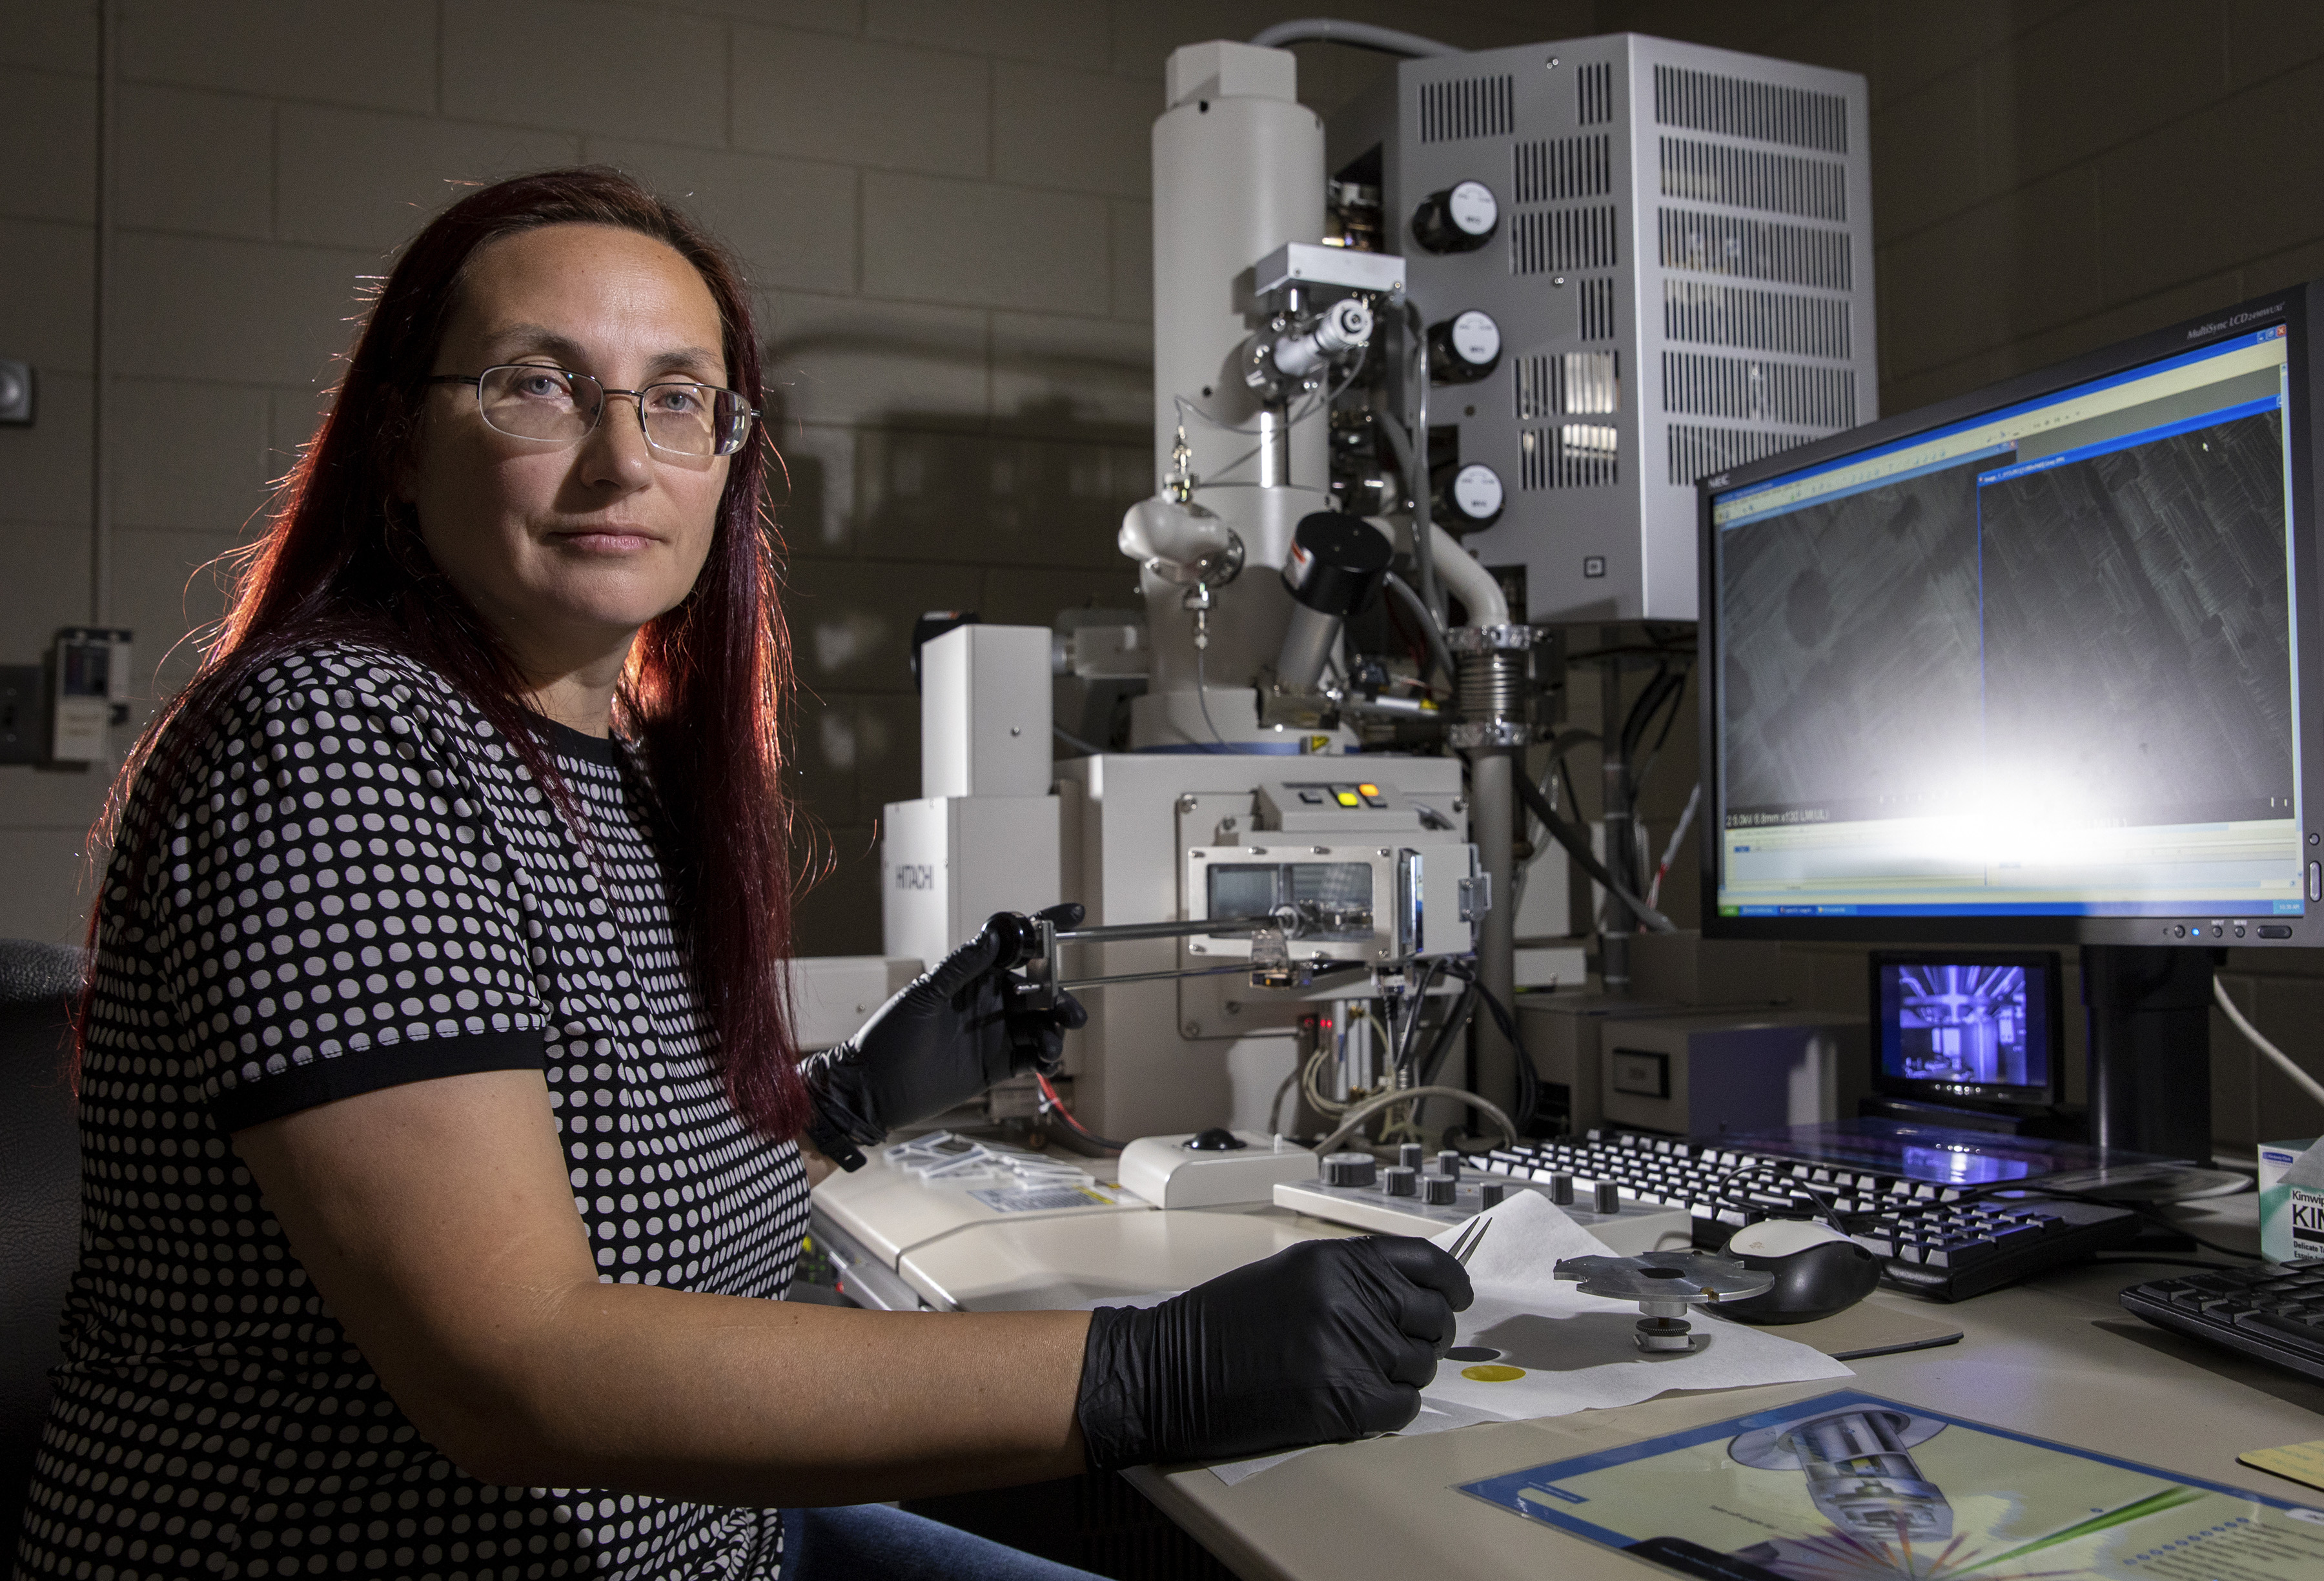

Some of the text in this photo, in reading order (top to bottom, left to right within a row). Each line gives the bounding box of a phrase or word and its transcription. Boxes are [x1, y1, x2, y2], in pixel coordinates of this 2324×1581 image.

[1708, 473, 1730, 488] NEC
[895, 864, 934, 890] HITACHI
[2294, 1241, 2318, 1251] Delicate
